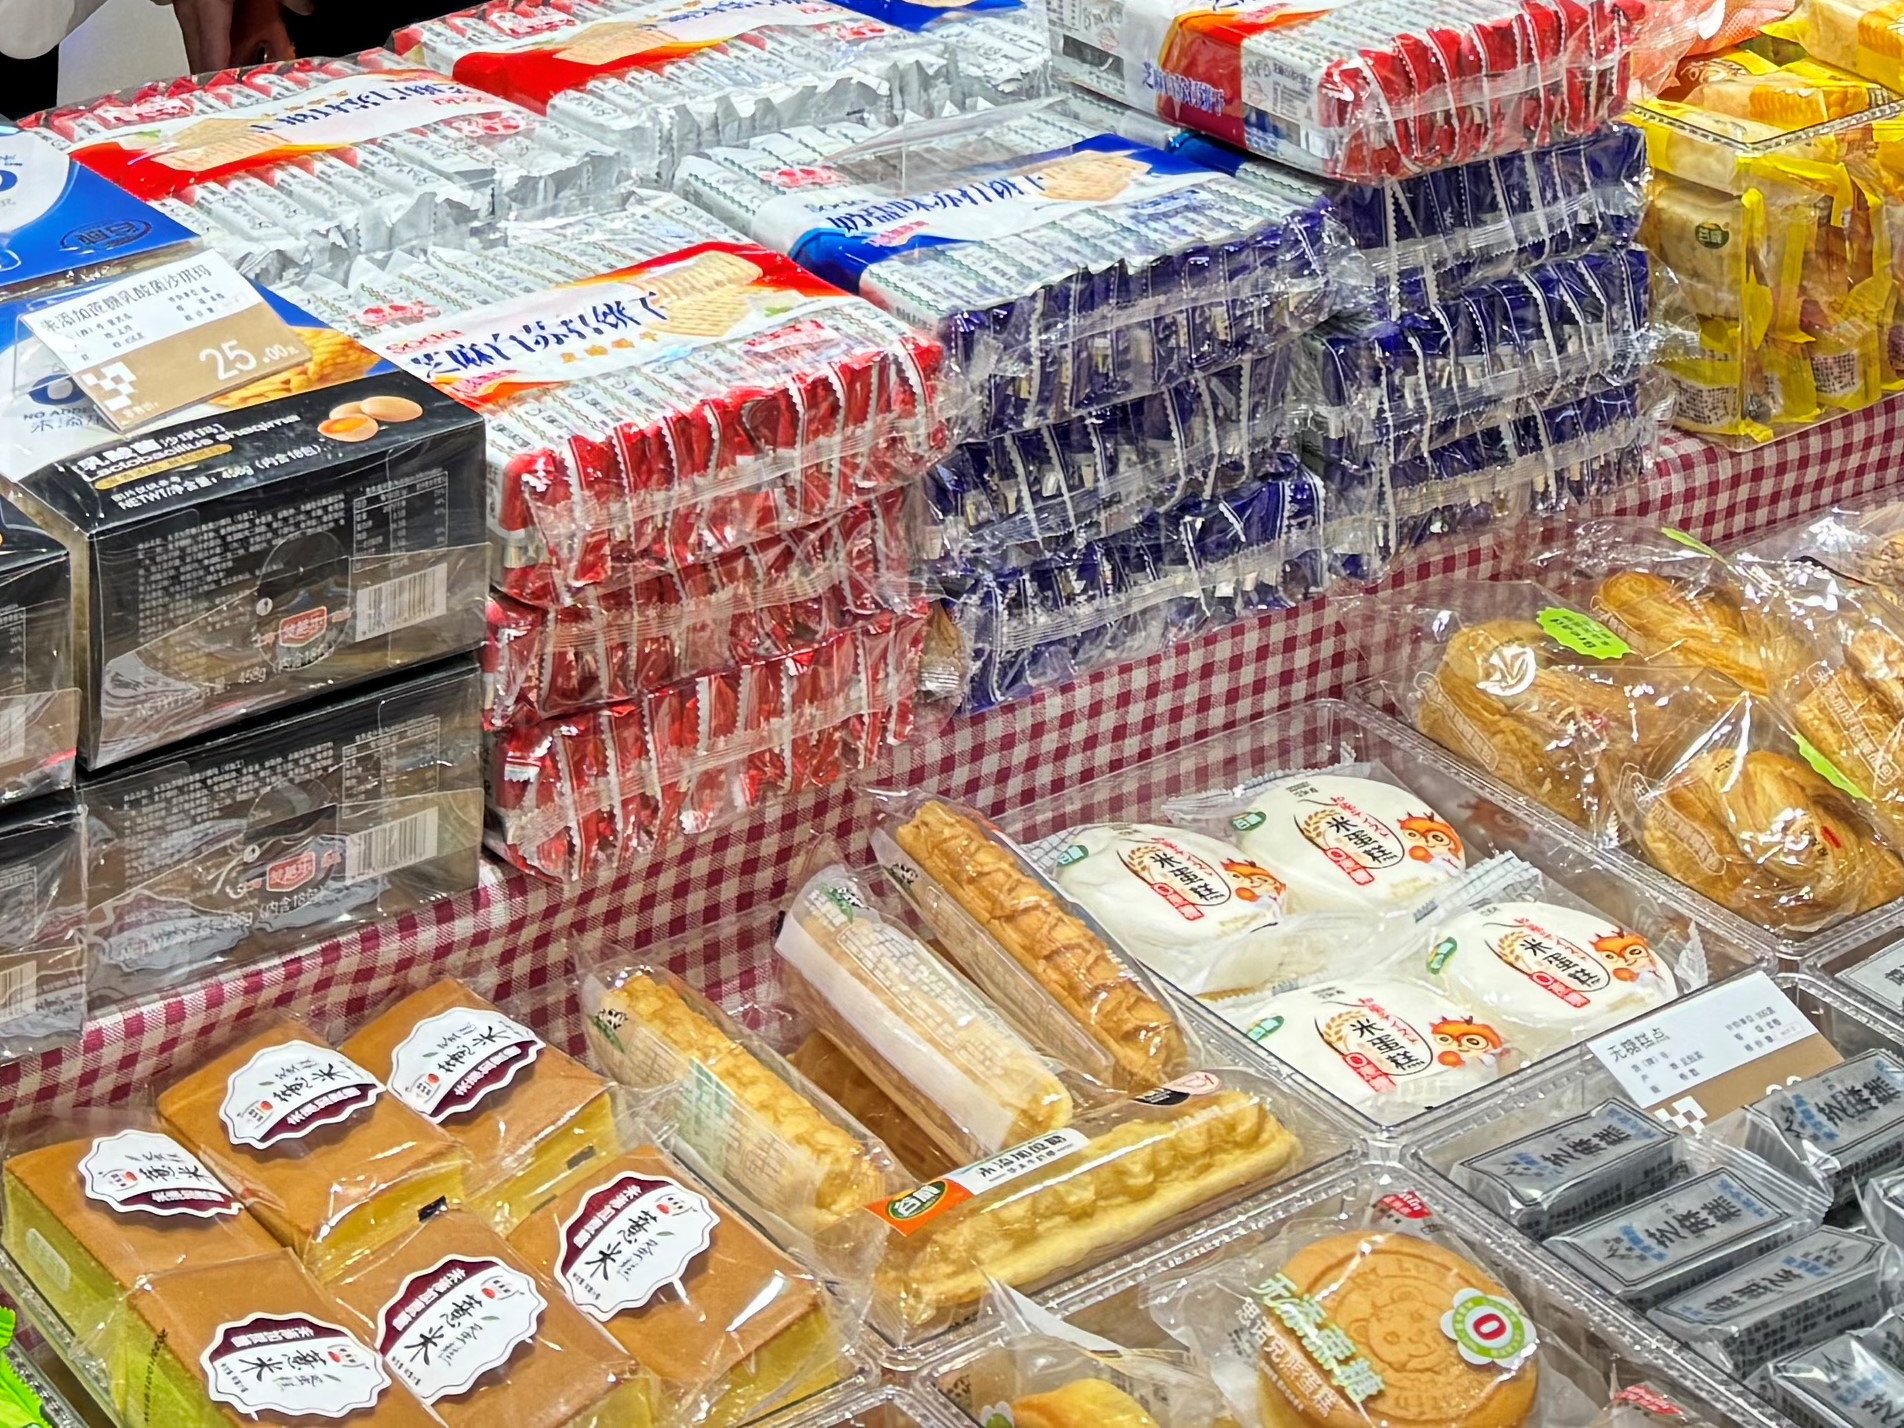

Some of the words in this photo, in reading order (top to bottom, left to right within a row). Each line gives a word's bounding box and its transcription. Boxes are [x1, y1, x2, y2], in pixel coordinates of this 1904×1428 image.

[1321, 807, 1405, 870] 米蛋糕
[1146, 846, 1228, 908] 米蛋糕
[1521, 930, 1602, 990] 米蛋糕
[1351, 1016, 1432, 1076] 米蛋糕
[1607, 1027, 1671, 1062] 无糖糕点
